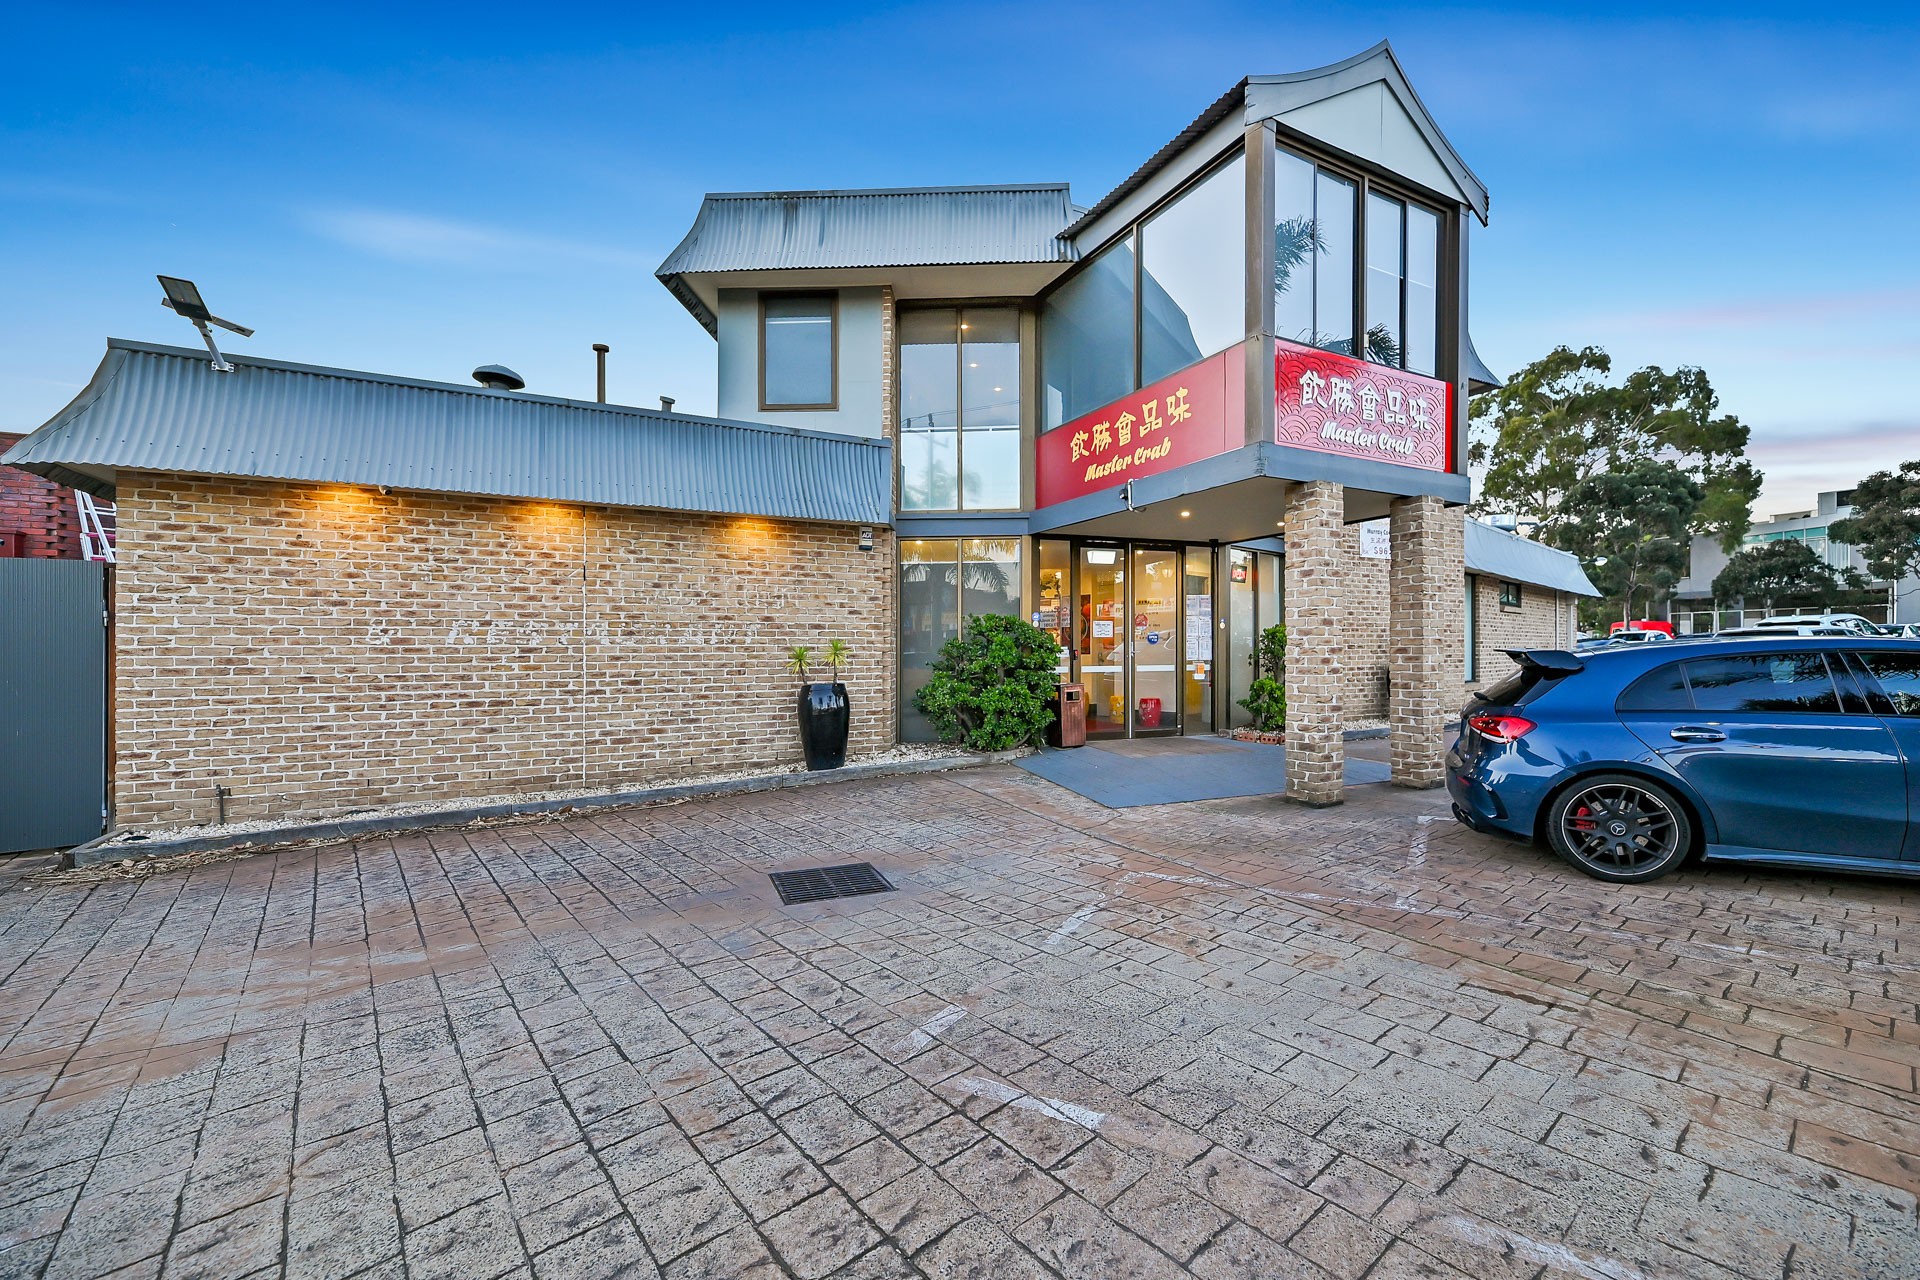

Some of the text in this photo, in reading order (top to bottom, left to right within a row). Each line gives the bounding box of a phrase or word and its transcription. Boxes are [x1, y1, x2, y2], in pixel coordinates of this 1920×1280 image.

[1070, 387, 1192, 463] 飲勝會品味
[1299, 369, 1432, 431] 飲勝會品味
[1084, 437, 1172, 482] Master Crab
[1320, 421, 1415, 455] Master Crab
